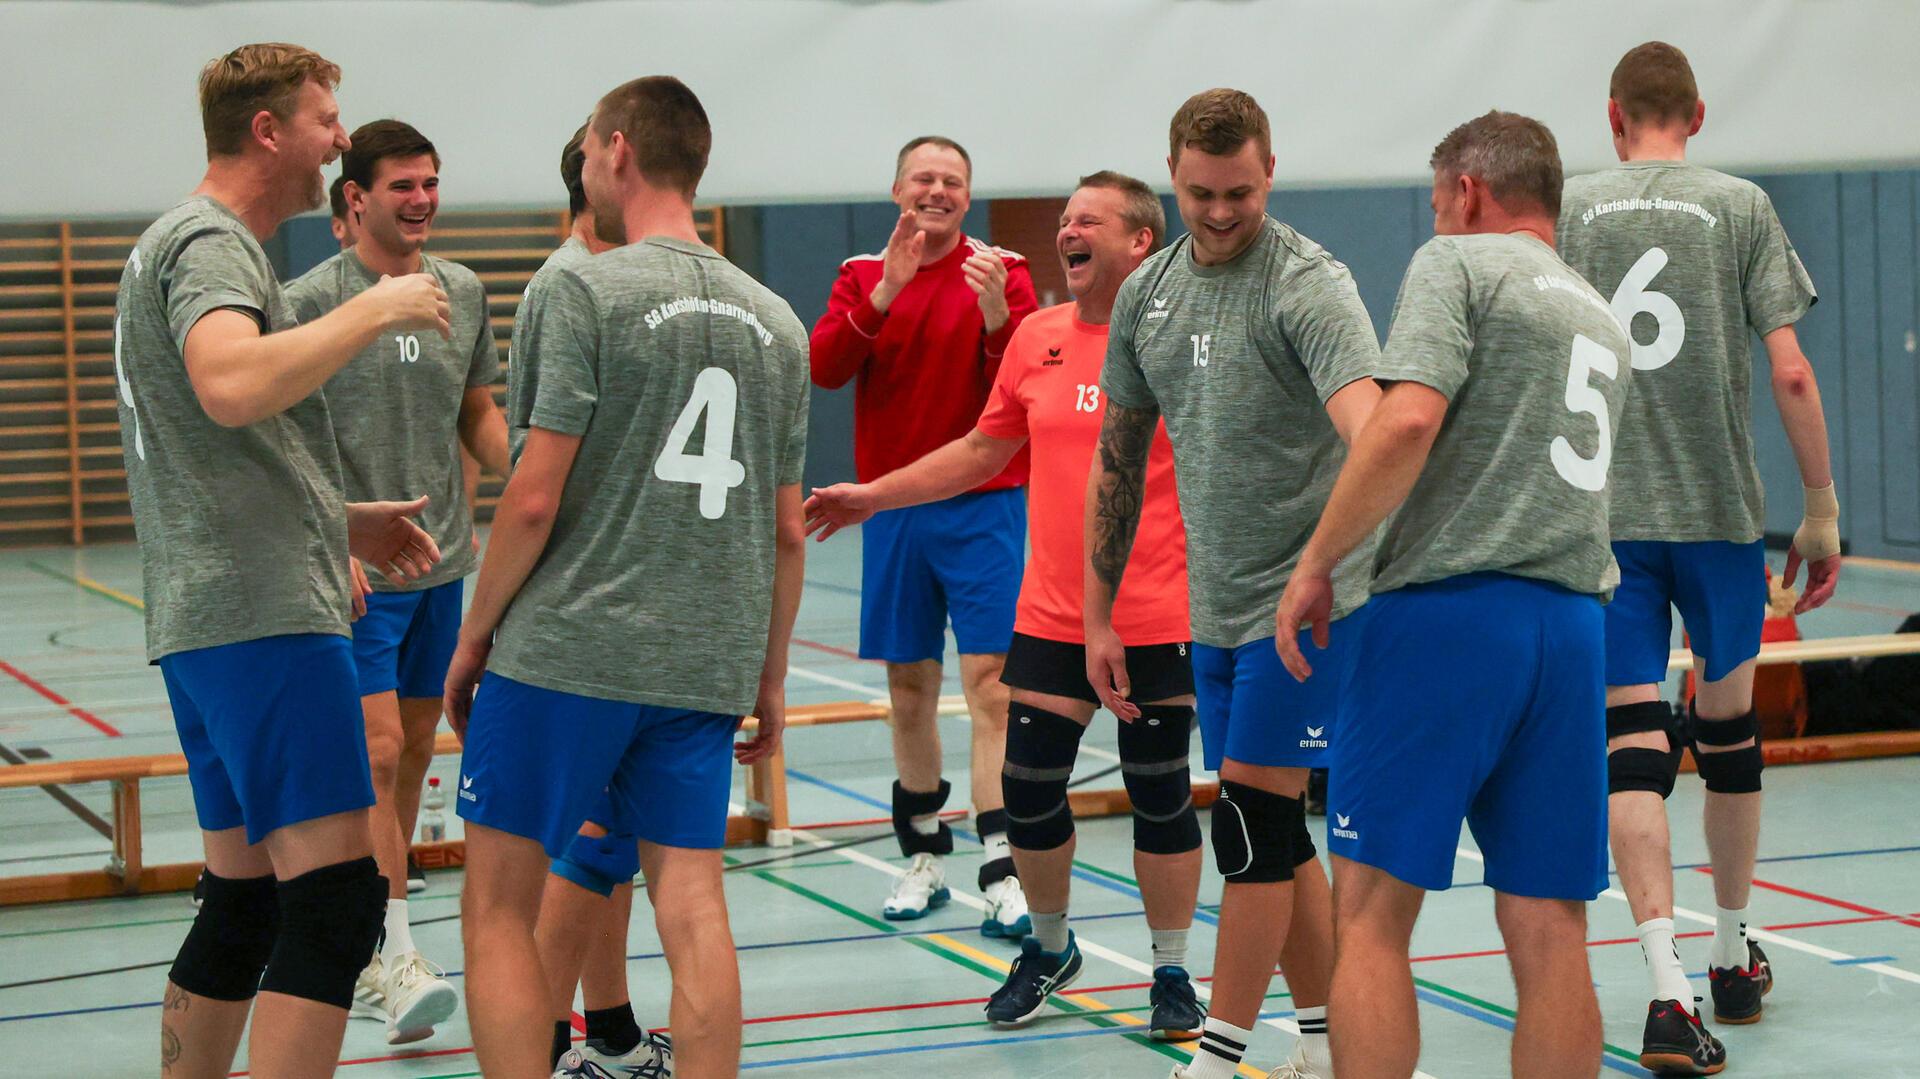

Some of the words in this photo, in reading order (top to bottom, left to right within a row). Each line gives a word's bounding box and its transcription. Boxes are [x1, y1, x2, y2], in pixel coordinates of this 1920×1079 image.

[1582, 209, 1595, 226] SG
[1594, 197, 1718, 228] Karlshöfen-Gnarrenburg
[644, 308, 664, 330] SG
[1147, 309, 1169, 320] erima
[1609, 246, 1686, 371] 6
[395, 335, 420, 363] 10
[1190, 334, 1211, 367] 15
[1076, 384, 1100, 413] 13
[1550, 333, 1619, 492] 5
[654, 366, 746, 520] 4
[1299, 739, 1328, 748] erima
